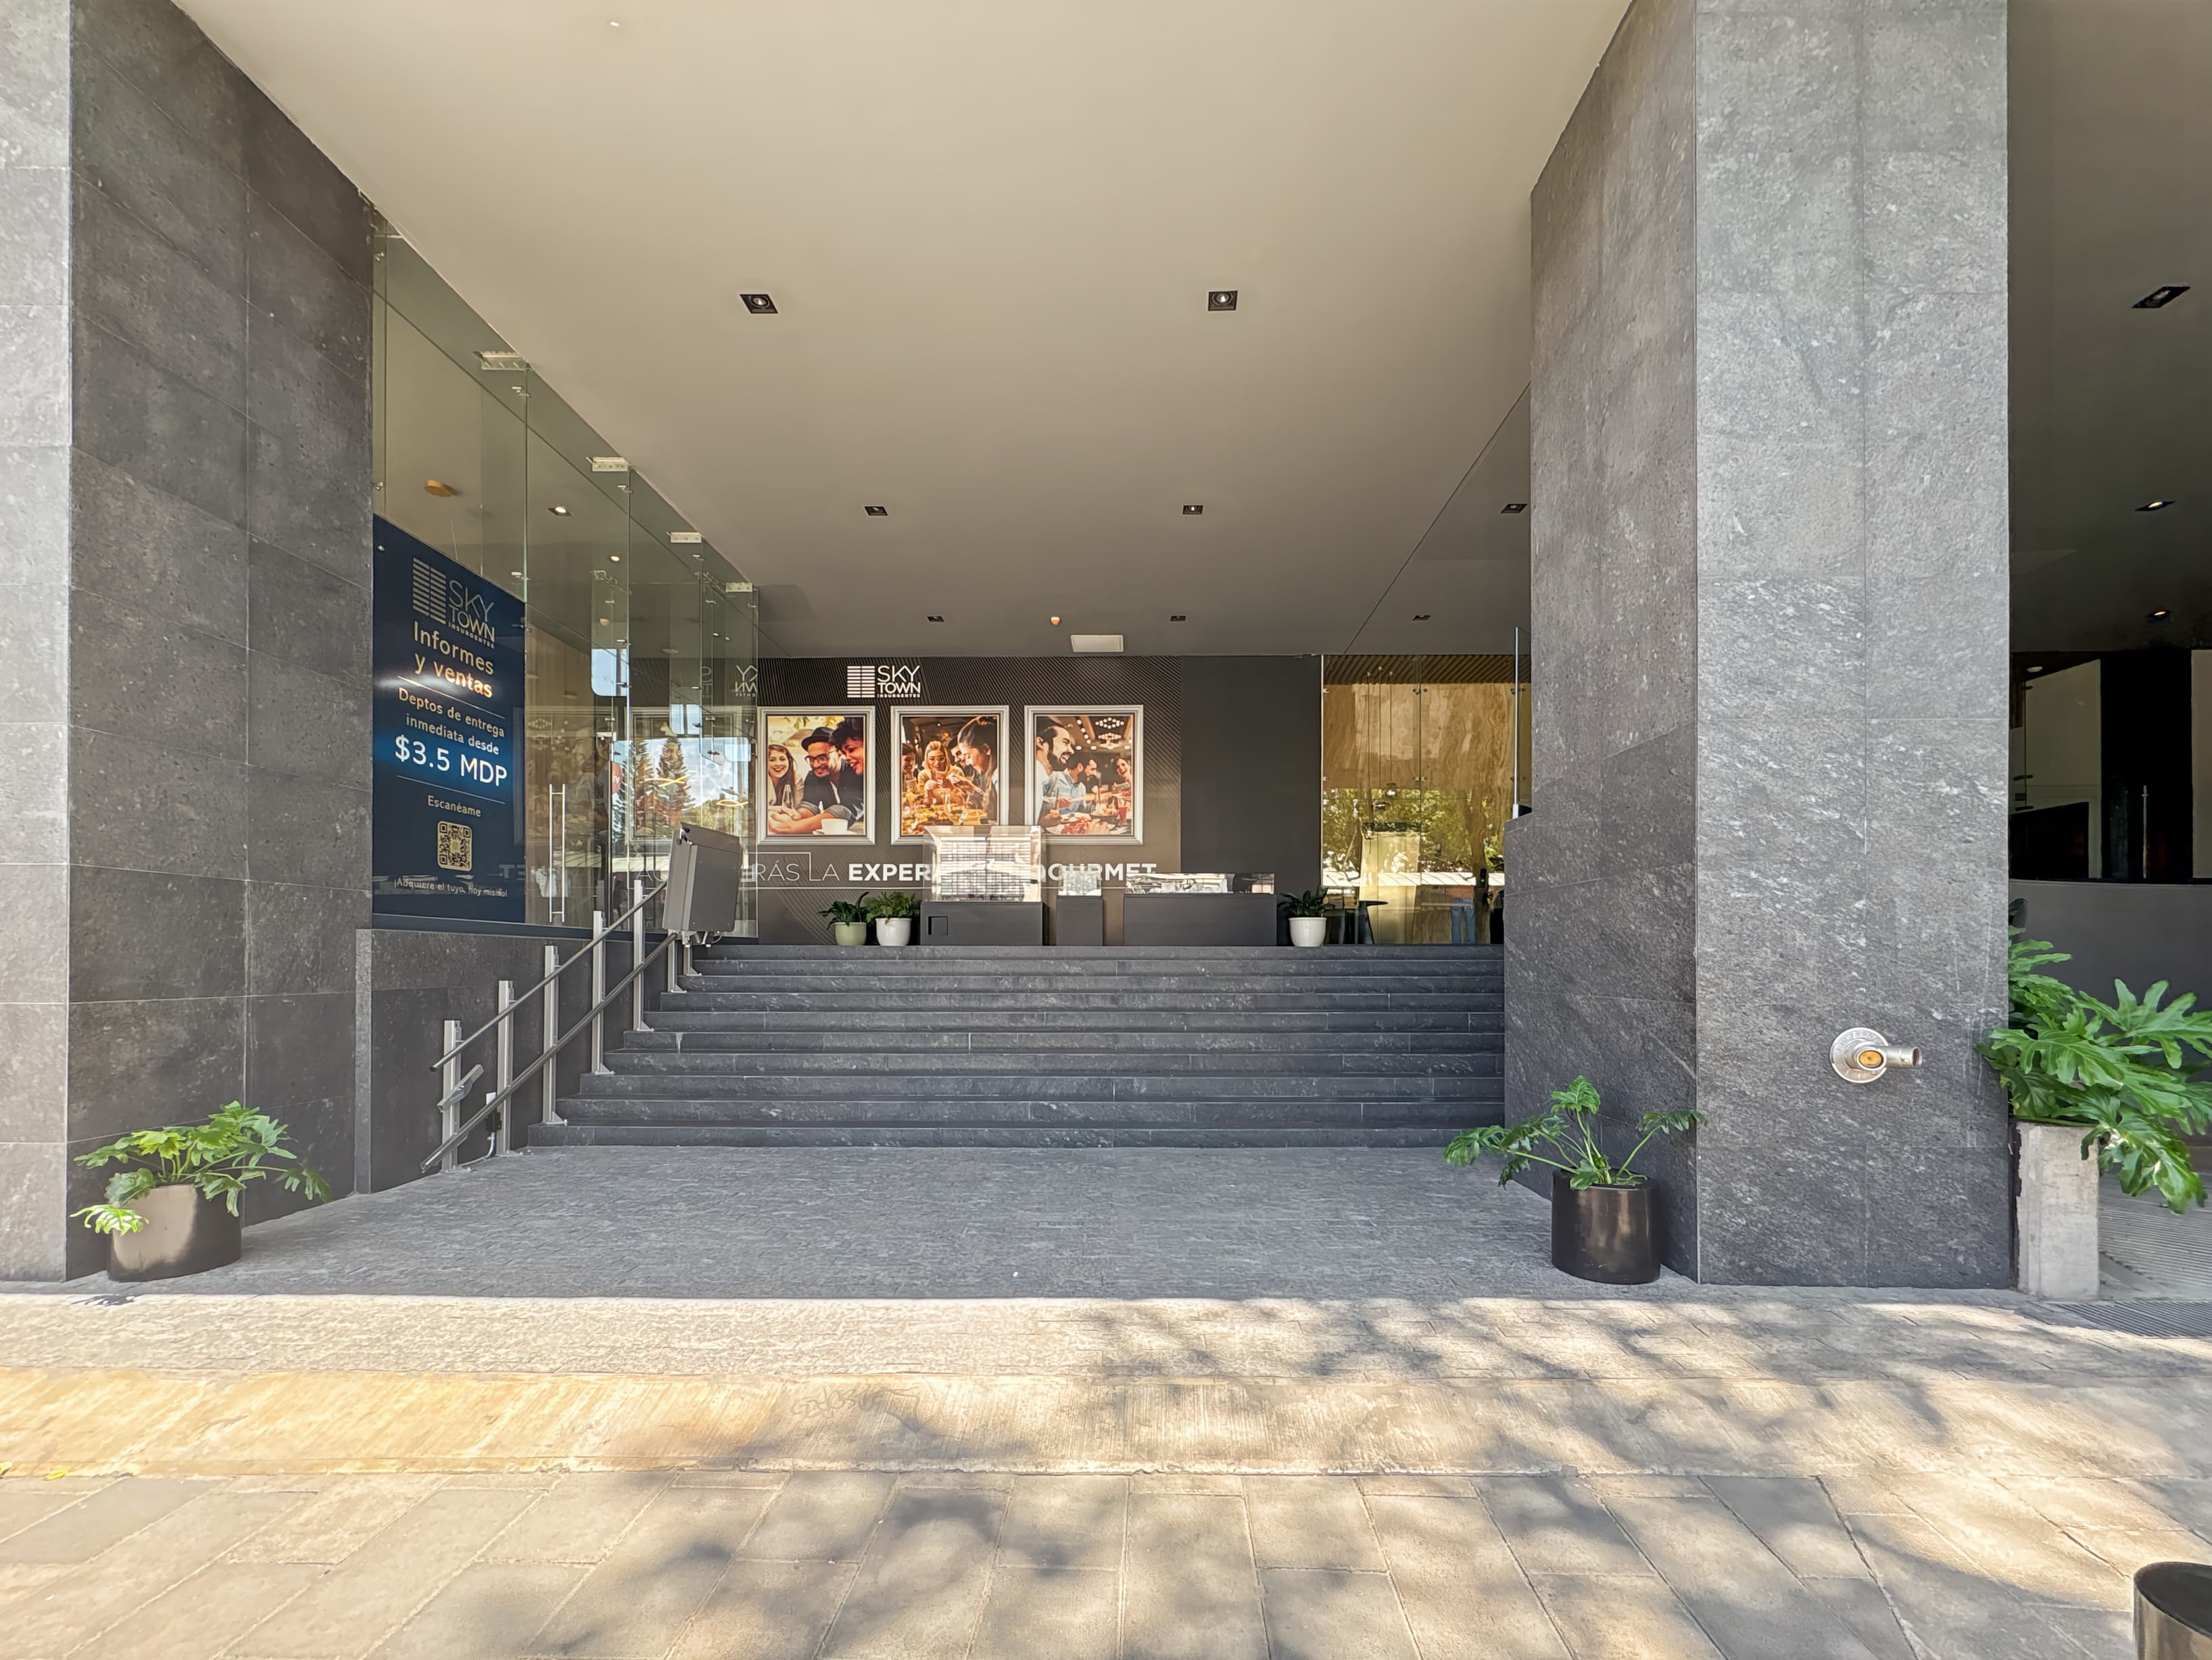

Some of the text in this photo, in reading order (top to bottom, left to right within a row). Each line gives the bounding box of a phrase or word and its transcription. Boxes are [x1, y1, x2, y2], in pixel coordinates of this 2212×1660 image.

[449, 579, 494, 623] SKY
[448, 621, 495, 649] INSURGENTES
[449, 604, 495, 643] TOWN
[414, 621, 494, 675] Informes
[415, 653, 493, 698] y ventas
[877, 665, 920, 682] SKY
[877, 682, 921, 694] TOWN
[398, 686, 505, 738] Deptos de entrega
[406, 713, 500, 755] inmediata desde
[395, 734, 508, 786] $3.5 MDP
[427, 795, 481, 817] Escanéame
[437, 882, 444, 891] el
[1041, 863, 1157, 882] OURMET
